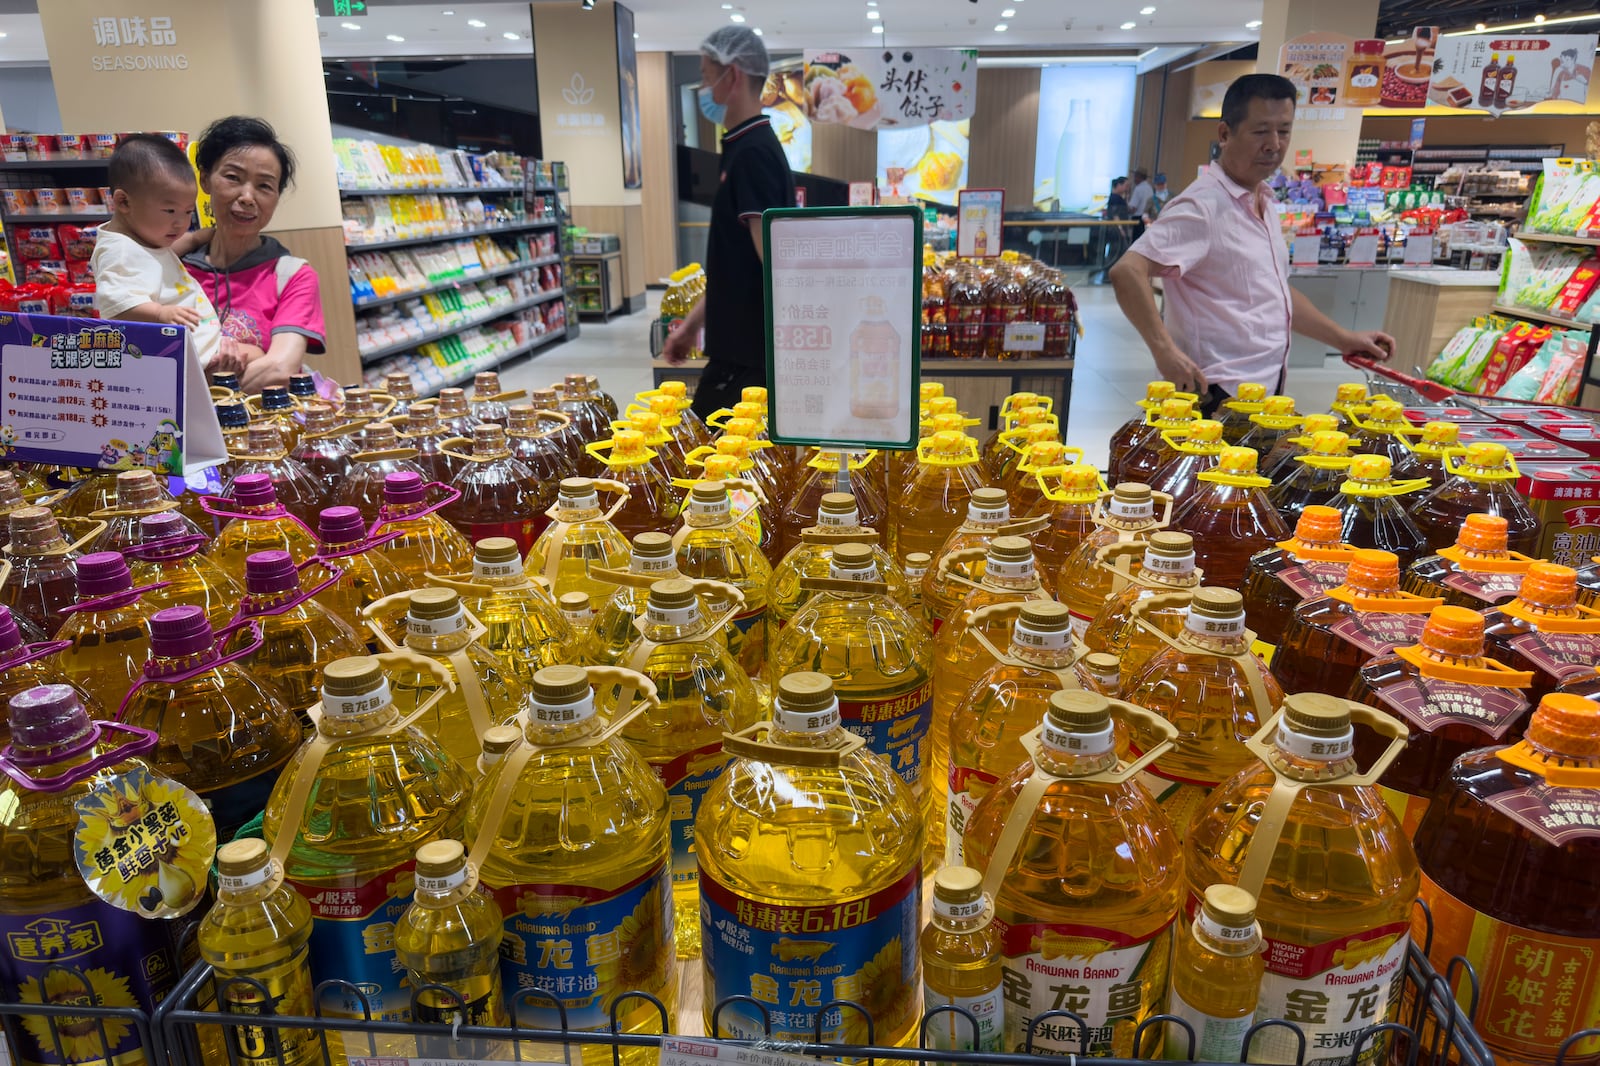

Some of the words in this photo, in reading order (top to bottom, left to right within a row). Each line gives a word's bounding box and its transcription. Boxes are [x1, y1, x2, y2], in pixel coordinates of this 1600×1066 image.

[93, 16, 177, 47] 调味品
[92, 54, 189, 72] SEASONING
[1471, 40, 1486, 68] 纯正
[881, 68, 929, 94] 头伏
[900, 95, 945, 119] 饺子
[51, 331, 122, 349] 吃点亚麻酸
[51, 350, 122, 369] 无限多巴胺
[981, 510, 1004, 520] 金龙鱼
[1122, 505, 1146, 515] 金龙鱼
[482, 566, 511, 576] 金龙鱼
[1152, 558, 1182, 570] 金龙鱼
[1205, 621, 1238, 632] 金龙鱼
[342, 698, 381, 714] 金龙鱼
[1427, 693, 1482, 706] 中国发明专利
[537, 708, 575, 722] 金龙鱼
[1417, 701, 1499, 723] 去除黄曲霉毒素
[1046, 730, 1082, 750] 金龙鱼
[94, 800, 180, 873] 黄金小黑葵
[418, 877, 447, 888] 金龙鱼
[325, 891, 357, 904] 脱壳
[319, 905, 362, 915] 物理压榨
[736, 897, 878, 934] 特惠装6.18L
[949, 904, 979, 917] 金龙鱼
[515, 919, 560, 935] ARAWANA
[563, 921, 596, 935] BRAND
[724, 920, 751, 942] 脱壳
[14, 928, 97, 957] 营养家
[721, 932, 755, 955] 物理压榨
[1272, 941, 1305, 954] WORLD
[1271, 948, 1301, 960] HEART
[1271, 955, 1289, 965] DAY
[769, 963, 810, 977] ARAWANA
[814, 963, 842, 976] BRAND
[1026, 957, 1079, 979] ARAWANA
[1083, 966, 1120, 980] BRAND
[1325, 970, 1374, 985] ARAWANA
[517, 971, 598, 993] 葵花籽油
[750, 973, 864, 1007] 金龙鱼
[1498, 944, 1554, 1038] 胡姬花
[1002, 966, 1144, 1018] 金龙鱼
[1544, 956, 1582, 1037] 古法花生油
[770, 1010, 842, 1029] 葵花籽油
